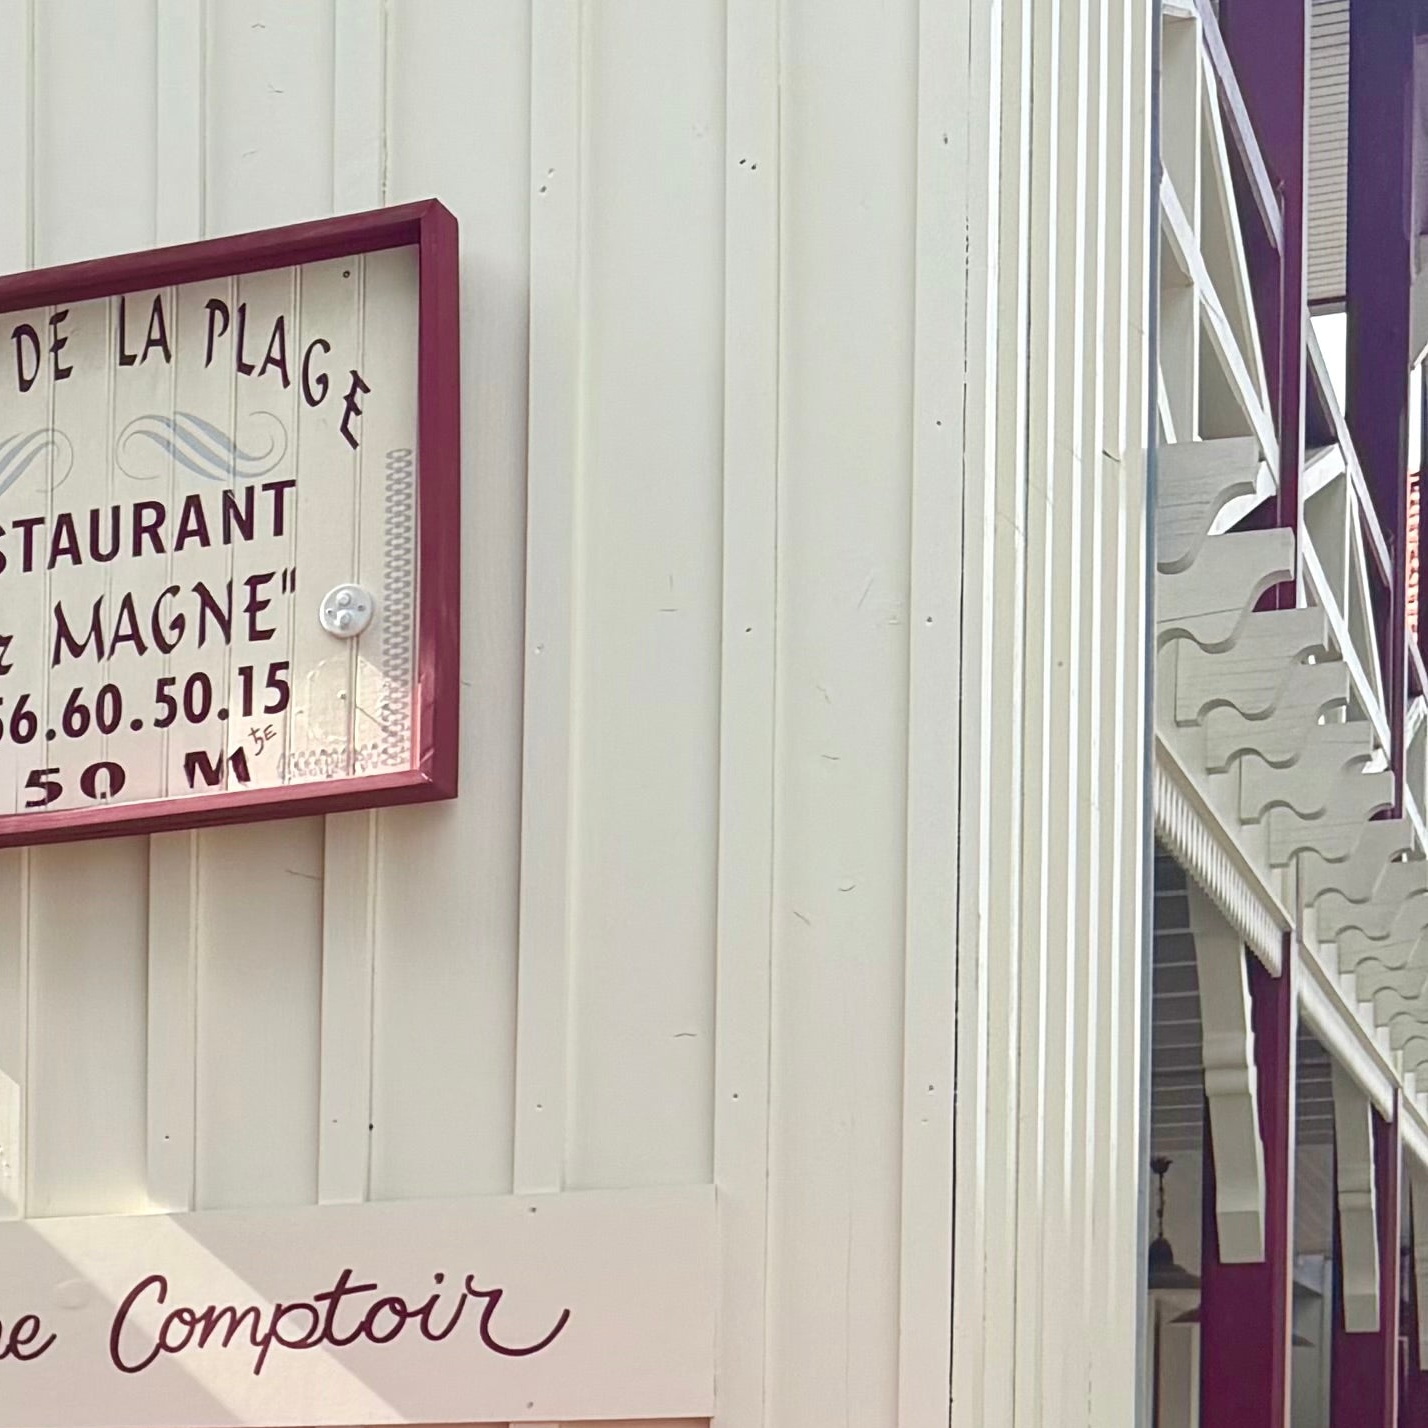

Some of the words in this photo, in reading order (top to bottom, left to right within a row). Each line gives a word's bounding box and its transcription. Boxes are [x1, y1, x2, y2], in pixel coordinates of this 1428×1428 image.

[11, 308, 75, 393] DE
[117, 293, 173, 366] LA
[205, 297, 371, 449] PLAGE
[51, 567, 297, 668] MAGNE"
[24, 761, 126, 809] 50
[109, 1268, 572, 1376] Comptoir
